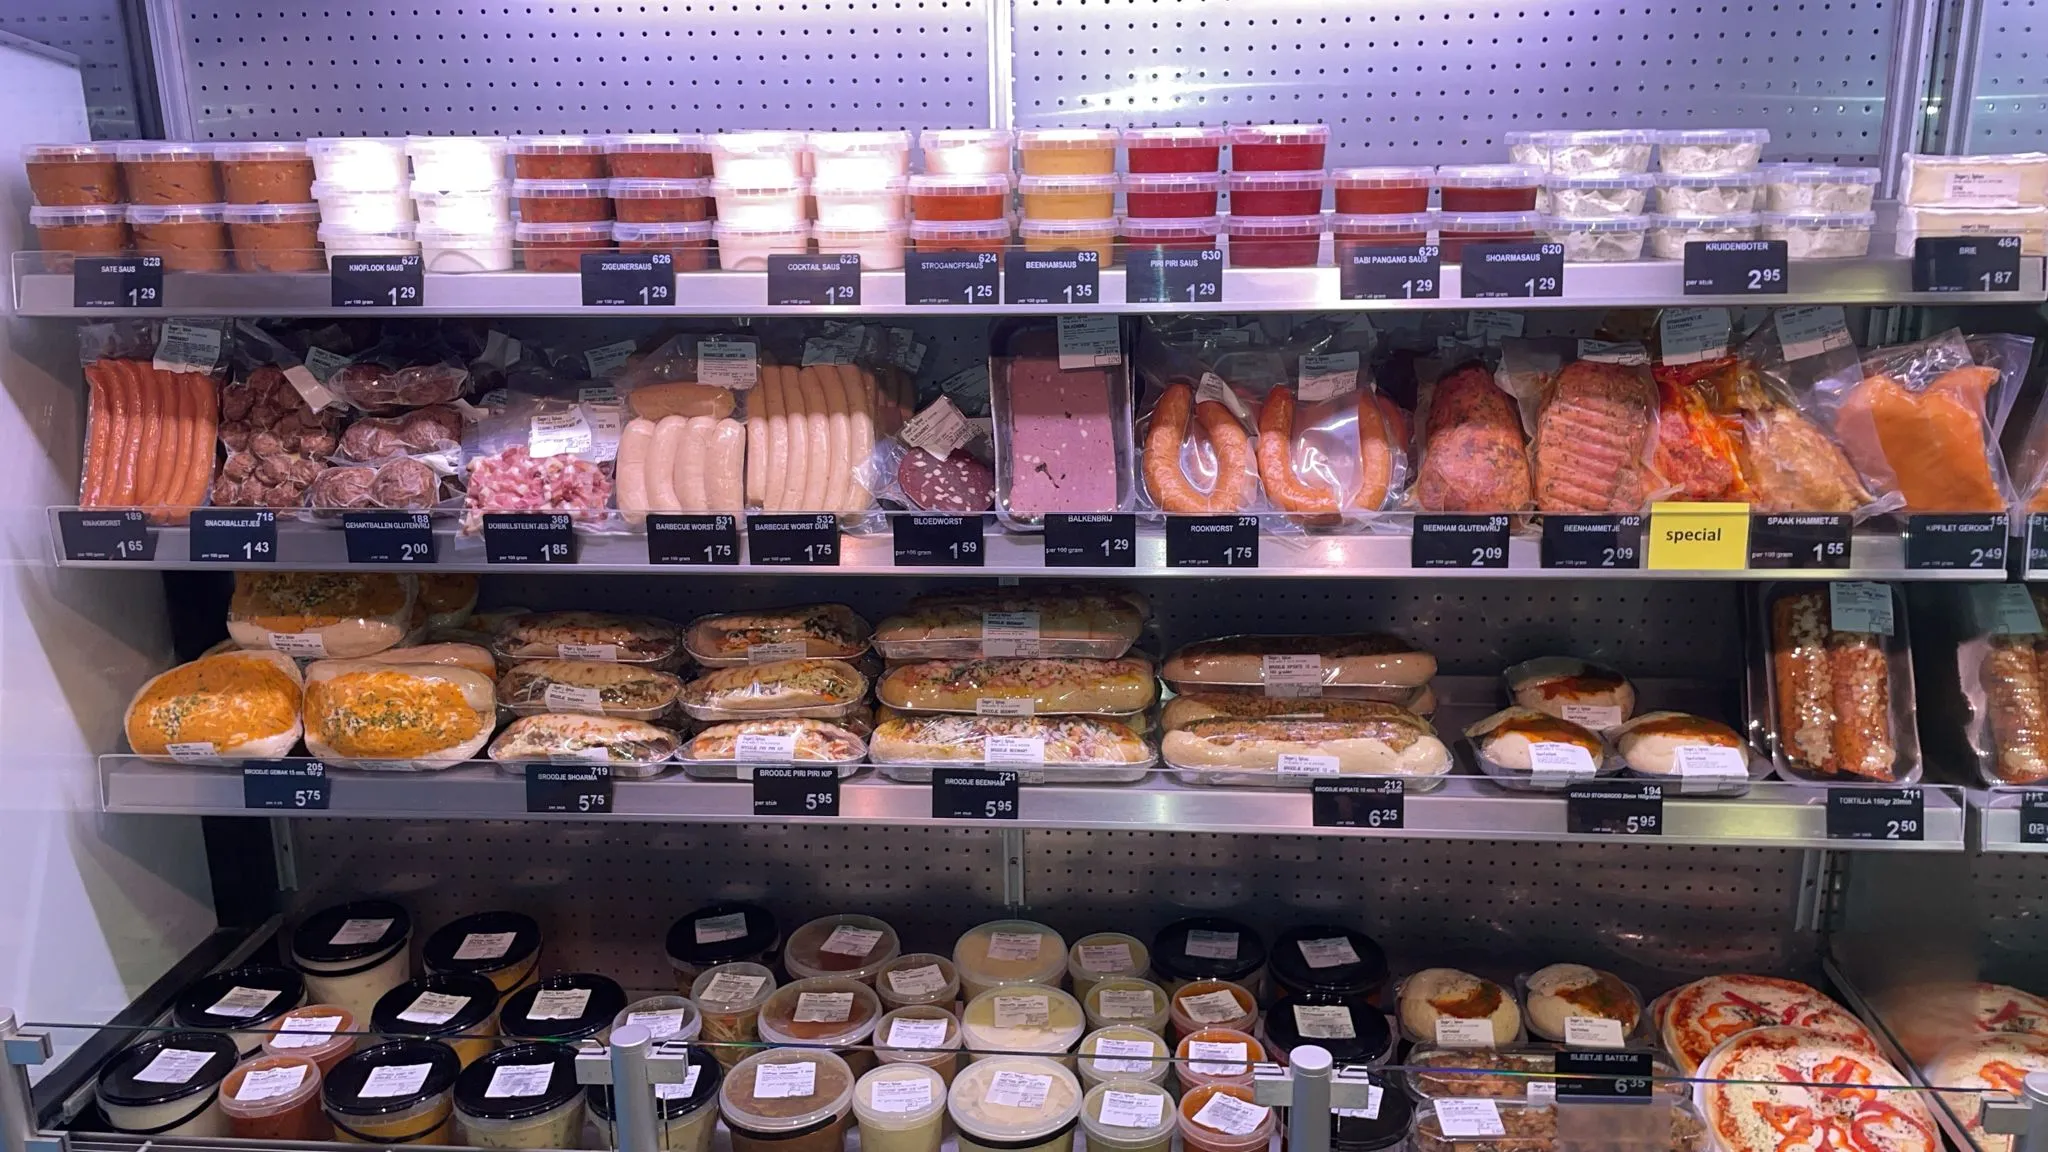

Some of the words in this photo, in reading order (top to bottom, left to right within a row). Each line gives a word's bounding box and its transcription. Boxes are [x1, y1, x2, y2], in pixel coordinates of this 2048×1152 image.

[1706, 242, 1768, 251] KRUIDENBOTER
[1998, 238, 2018, 247] 464
[1418, 246, 1438, 256] 629
[1541, 244, 1561, 254] 620
[1959, 246, 1976, 254] BRIE
[652, 255, 671, 264] 626
[840, 254, 858, 264] 625
[978, 254, 998, 263] 624
[1077, 252, 1096, 262] 632
[1201, 250, 1220, 260] 630
[1353, 256, 1370, 264] BABI
[1372, 256, 1406, 264] PANGANG
[1408, 255, 1428, 263] SAUS
[1486, 254, 1540, 262] SHOARMASAUS
[143, 258, 160, 267] 628
[402, 256, 420, 266] 627
[922, 262, 984, 270] STROGANOFFSAUS
[1025, 261, 1076, 269] BEENHAMSAUS
[1164, 260, 1178, 268] PIRI
[349, 264, 385, 272] KNOFLOOK
[386, 264, 404, 272] SAUS
[602, 263, 652, 271] ZIGEUNERSAUS
[788, 263, 820, 271] COCKTAIL
[1763, 268, 1780, 281] 95
[1994, 271, 2012, 284] 87
[1199, 283, 1216, 295] 29
[1416, 280, 1432, 292] 29
[1539, 278, 1556, 290] 29
[141, 288, 156, 299] 29
[400, 286, 416, 298] 29
[652, 286, 668, 298] 29
[838, 286, 854, 298] 29
[977, 286, 993, 296] 25
[1076, 285, 1092, 296] 35
[125, 512, 142, 521] 189
[256, 512, 274, 522] 715
[412, 514, 429, 524] 188
[552, 515, 569, 524] 368
[716, 516, 732, 525] 531
[816, 515, 834, 524] 532
[914, 517, 962, 526] BLOEDWORST
[1068, 514, 1112, 522] BALKENBRIJ
[1238, 517, 1257, 526] 279
[1489, 517, 1508, 526] 393
[1620, 517, 1640, 526] 402
[1768, 516, 1794, 525] SPAAK
[1795, 516, 1838, 525] HAMMETJE
[488, 522, 549, 530] DOBBELSTEENTJES
[1423, 524, 1456, 532] BEENHAM
[1458, 524, 1500, 532] GLUTENVRIJ
[1564, 524, 1620, 532] BEENHAMMETJE
[1666, 528, 1721, 544] special
[128, 540, 143, 551] 65
[254, 542, 270, 553] 43
[414, 543, 428, 554] 00
[962, 542, 977, 553] 59
[1114, 538, 1129, 550] 29
[1827, 542, 1844, 555] 55
[552, 544, 568, 555] 85
[716, 544, 730, 556] 75
[816, 544, 832, 555] 75
[1236, 547, 1252, 558] 75
[1486, 547, 1502, 559] 09
[1616, 547, 1633, 560] 09
[1984, 548, 2002, 560] 49
[306, 762, 324, 772] 205
[590, 766, 608, 776] 719
[538, 773, 567, 781] BROODJE
[568, 773, 598, 781] SHOARMA
[760, 769, 792, 778] BROODJE
[792, 769, 806, 778] PIRI
[806, 769, 820, 778] PIRI
[820, 769, 832, 778] KIP
[1000, 772, 1016, 782] 721
[944, 778, 974, 786] BROODJE
[975, 778, 1006, 786] BEENHAM
[1384, 780, 1402, 790] 212
[306, 790, 321, 800] 75
[1642, 786, 1662, 796] 194
[1902, 790, 1921, 799] 711
[590, 794, 606, 805] 75
[818, 793, 832, 804] 95
[996, 800, 1012, 812] 95
[1382, 809, 1398, 820] 25
[1640, 816, 1656, 828] 95
[1901, 820, 1917, 832] 50
[1570, 1054, 1603, 1062] SLEETJE
[1604, 1054, 1638, 1062] SATETJE
